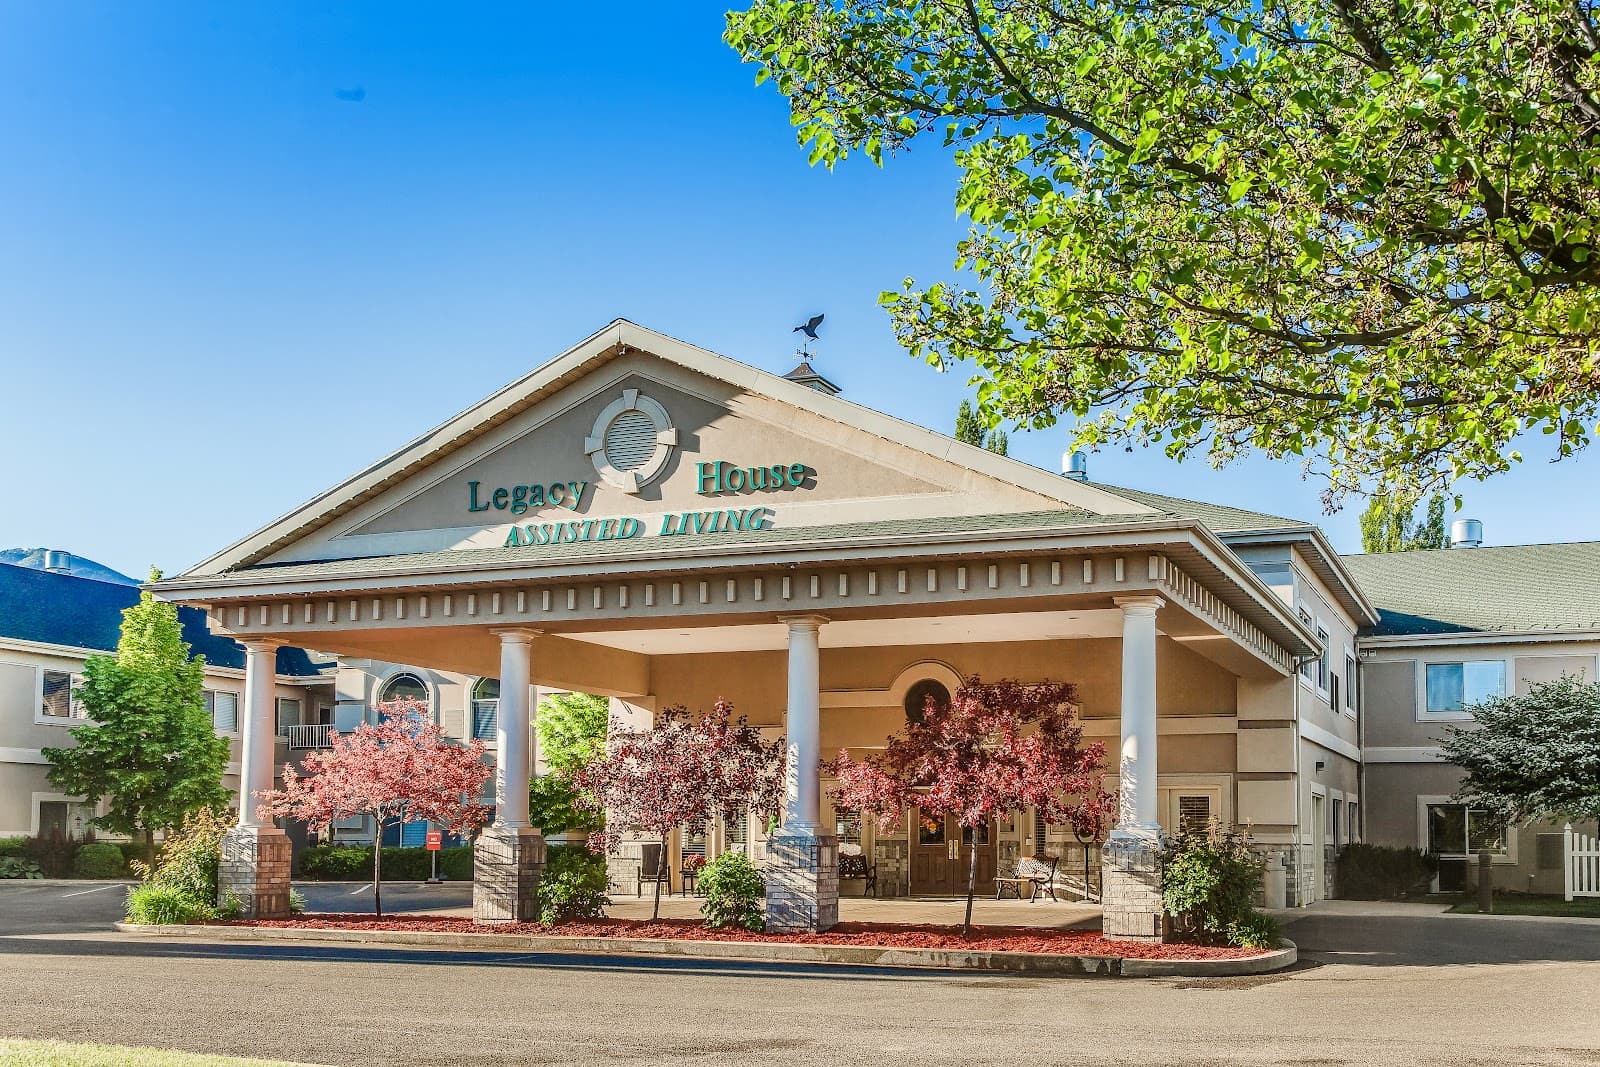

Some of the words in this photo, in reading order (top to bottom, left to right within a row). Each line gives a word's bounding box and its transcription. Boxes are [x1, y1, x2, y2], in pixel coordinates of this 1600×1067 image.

[468, 480, 588, 514] Legacy
[695, 460, 805, 494] House
[503, 517, 638, 548] ASSISTED
[659, 506, 766, 536] LIVING
